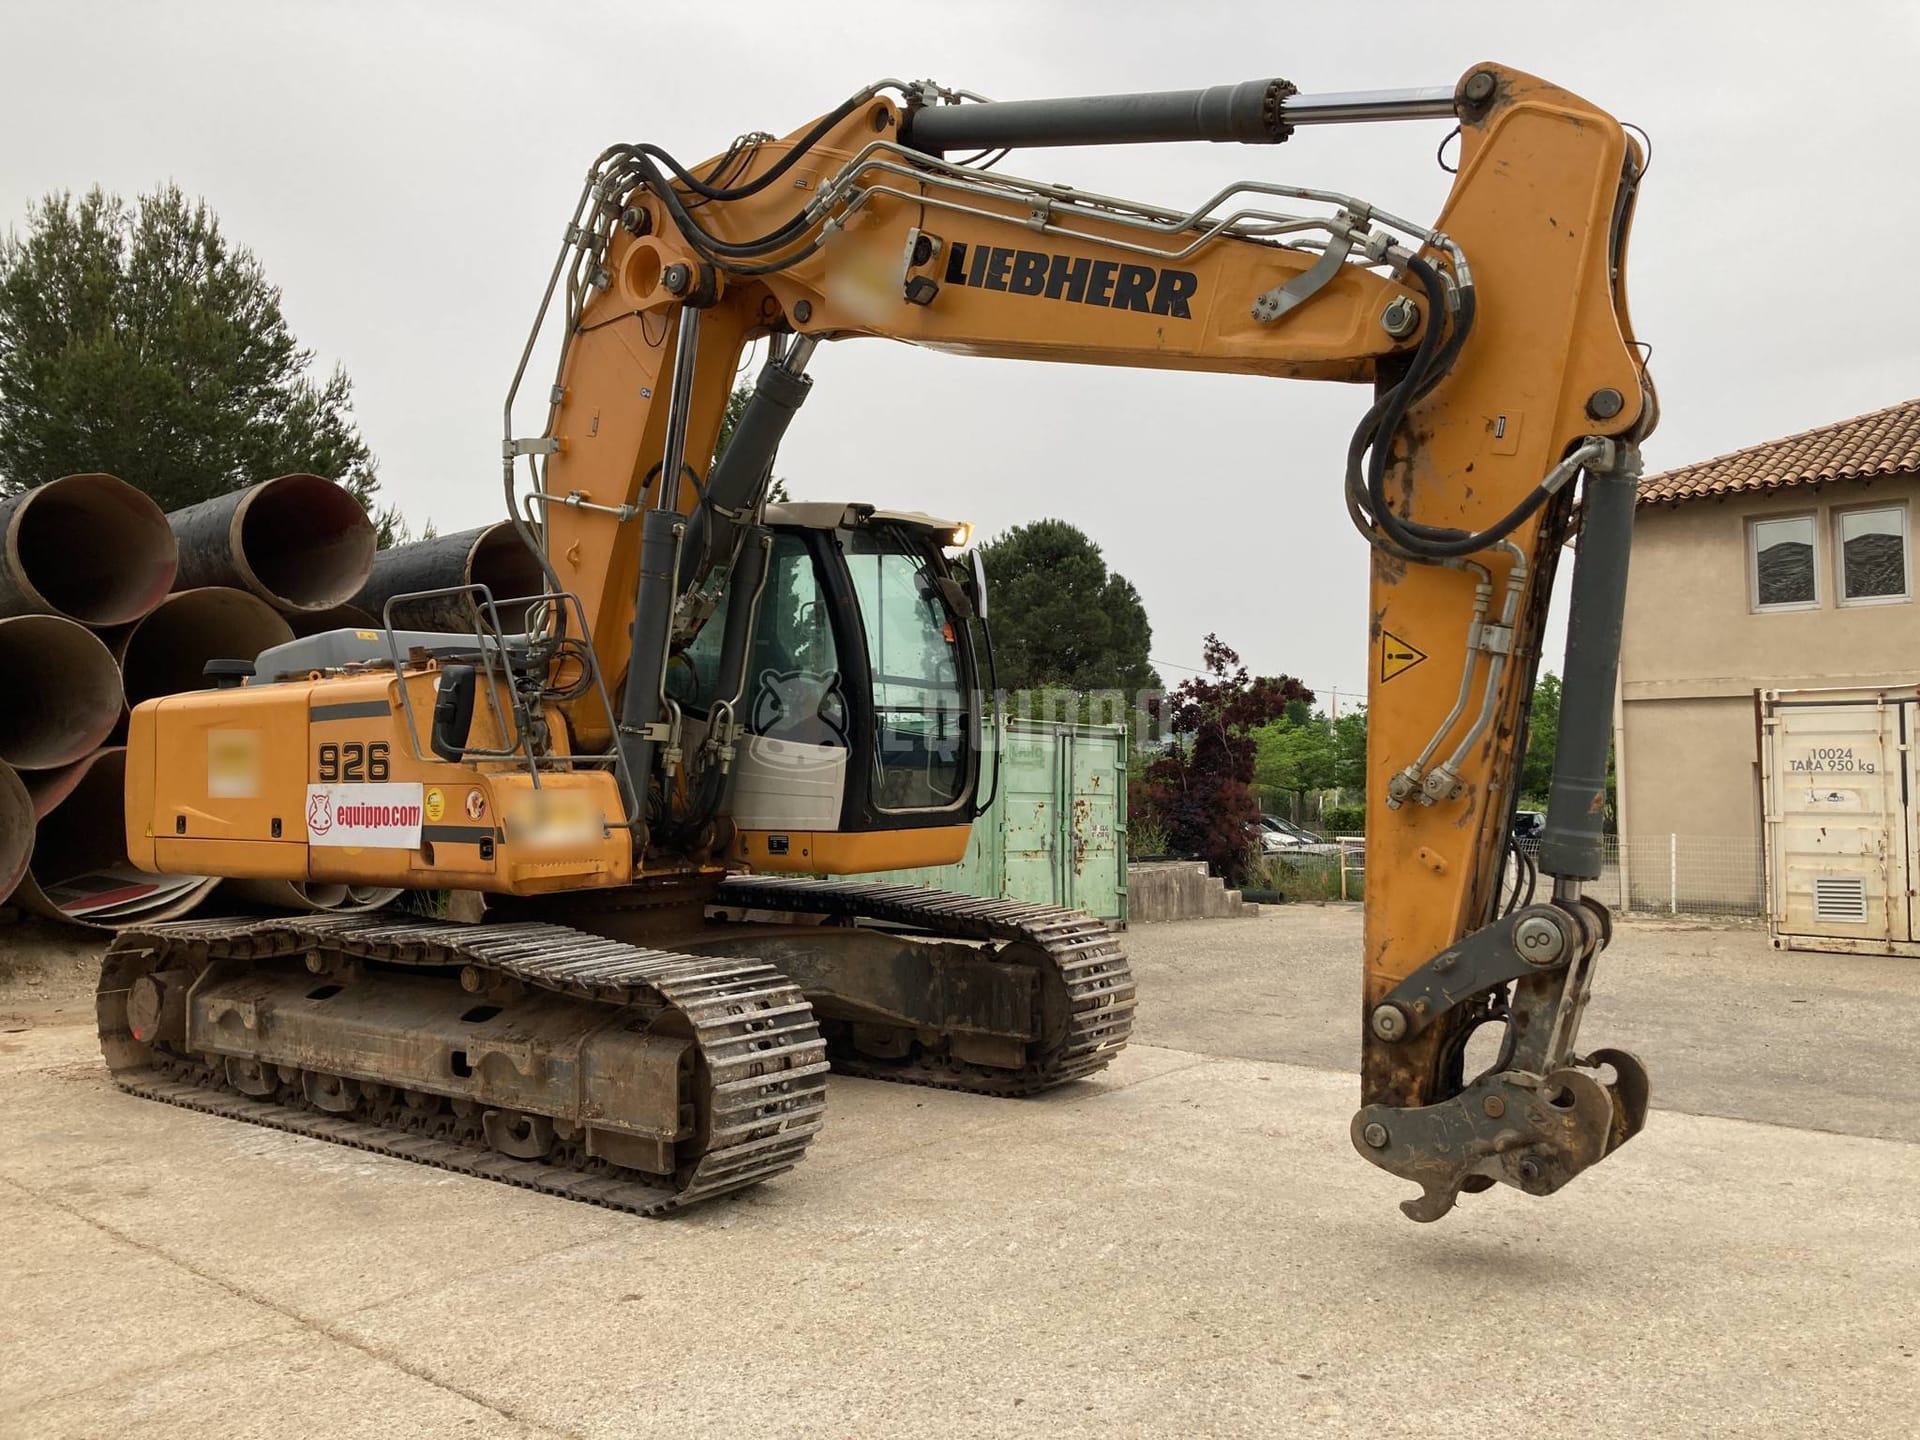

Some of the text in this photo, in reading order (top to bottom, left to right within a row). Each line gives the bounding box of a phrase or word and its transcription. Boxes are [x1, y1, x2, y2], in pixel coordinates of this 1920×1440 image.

[944, 242, 1198, 320] LIEBHERR
[319, 741, 390, 783] 926
[1789, 758, 1875, 774] TARA 950 kg
[1811, 747, 1853, 760] 10024
[336, 801, 421, 829] equippo.com
